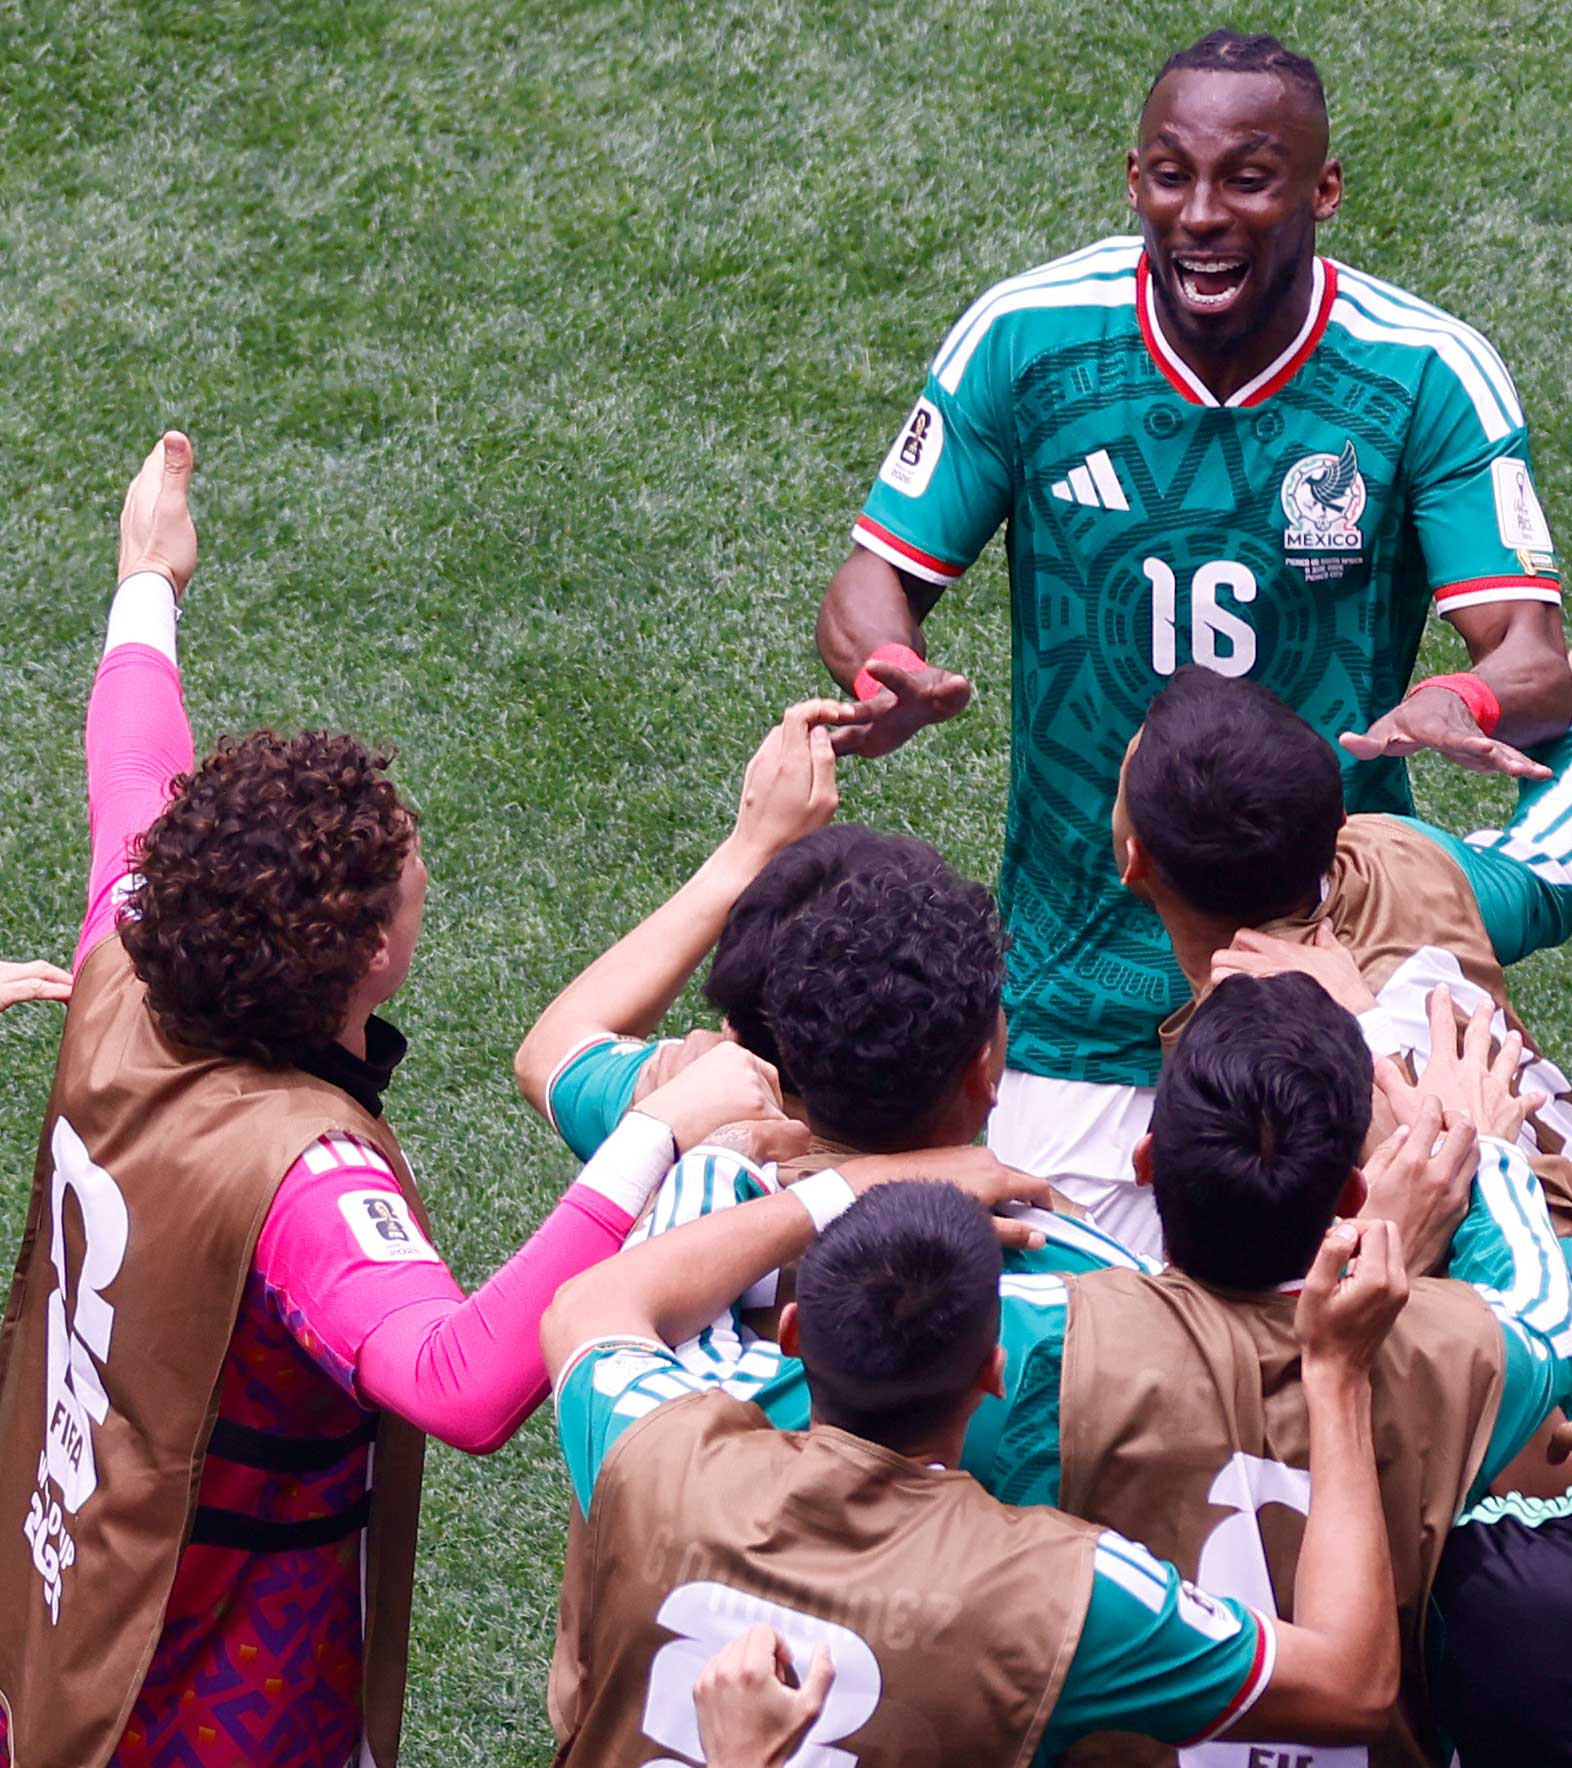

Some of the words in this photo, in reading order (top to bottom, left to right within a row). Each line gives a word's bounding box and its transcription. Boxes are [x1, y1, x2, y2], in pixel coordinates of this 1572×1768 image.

[1287, 530, 1359, 547] MÉXICO
[1143, 557, 1257, 678] 16
[50, 1400, 83, 1474] FIFA
